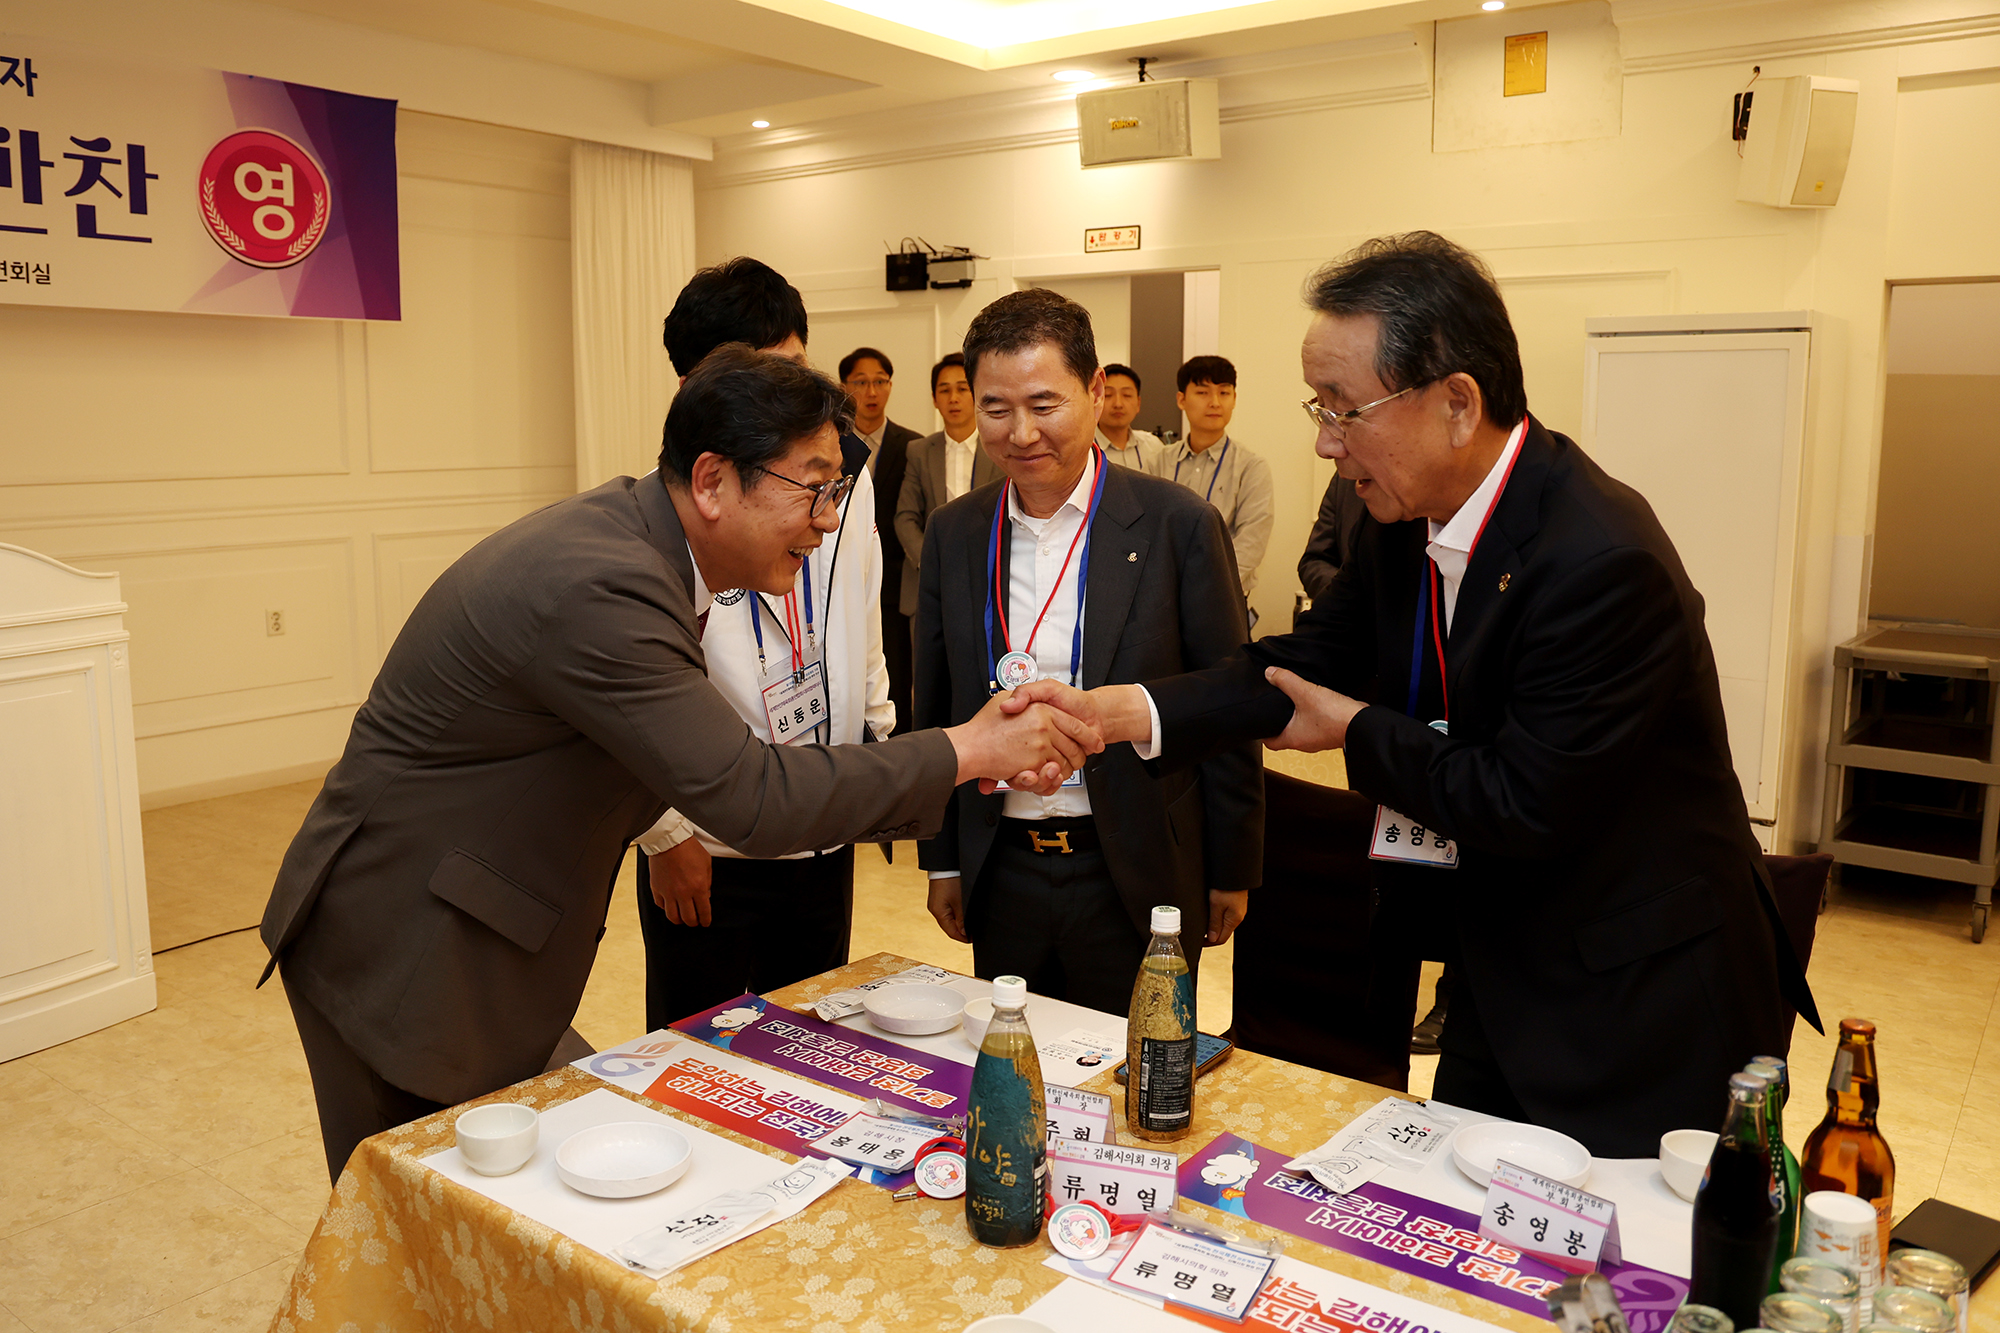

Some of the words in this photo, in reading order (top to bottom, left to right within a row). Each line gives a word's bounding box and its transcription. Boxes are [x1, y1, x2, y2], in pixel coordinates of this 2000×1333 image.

[234, 162, 295, 240] 영
[758, 1020, 859, 1056] 감동체전
[773, 1043, 879, 1081] 김해에서
[849, 1049, 934, 1080] 희망찬
[666, 1075, 767, 1118] 하나되는
[672, 1057, 766, 1095] 도약하는
[765, 1090, 849, 1125] 김해에
[869, 1074, 958, 1109] 활기찬
[1044, 1087, 1104, 1105] 계한인체육회총연합회
[1093, 1147, 1145, 1167] 김해시의회
[1150, 1156, 1172, 1171] 의장
[972, 1200, 1004, 1222] 막걸리
[1305, 1206, 1459, 1268] 김해에서
